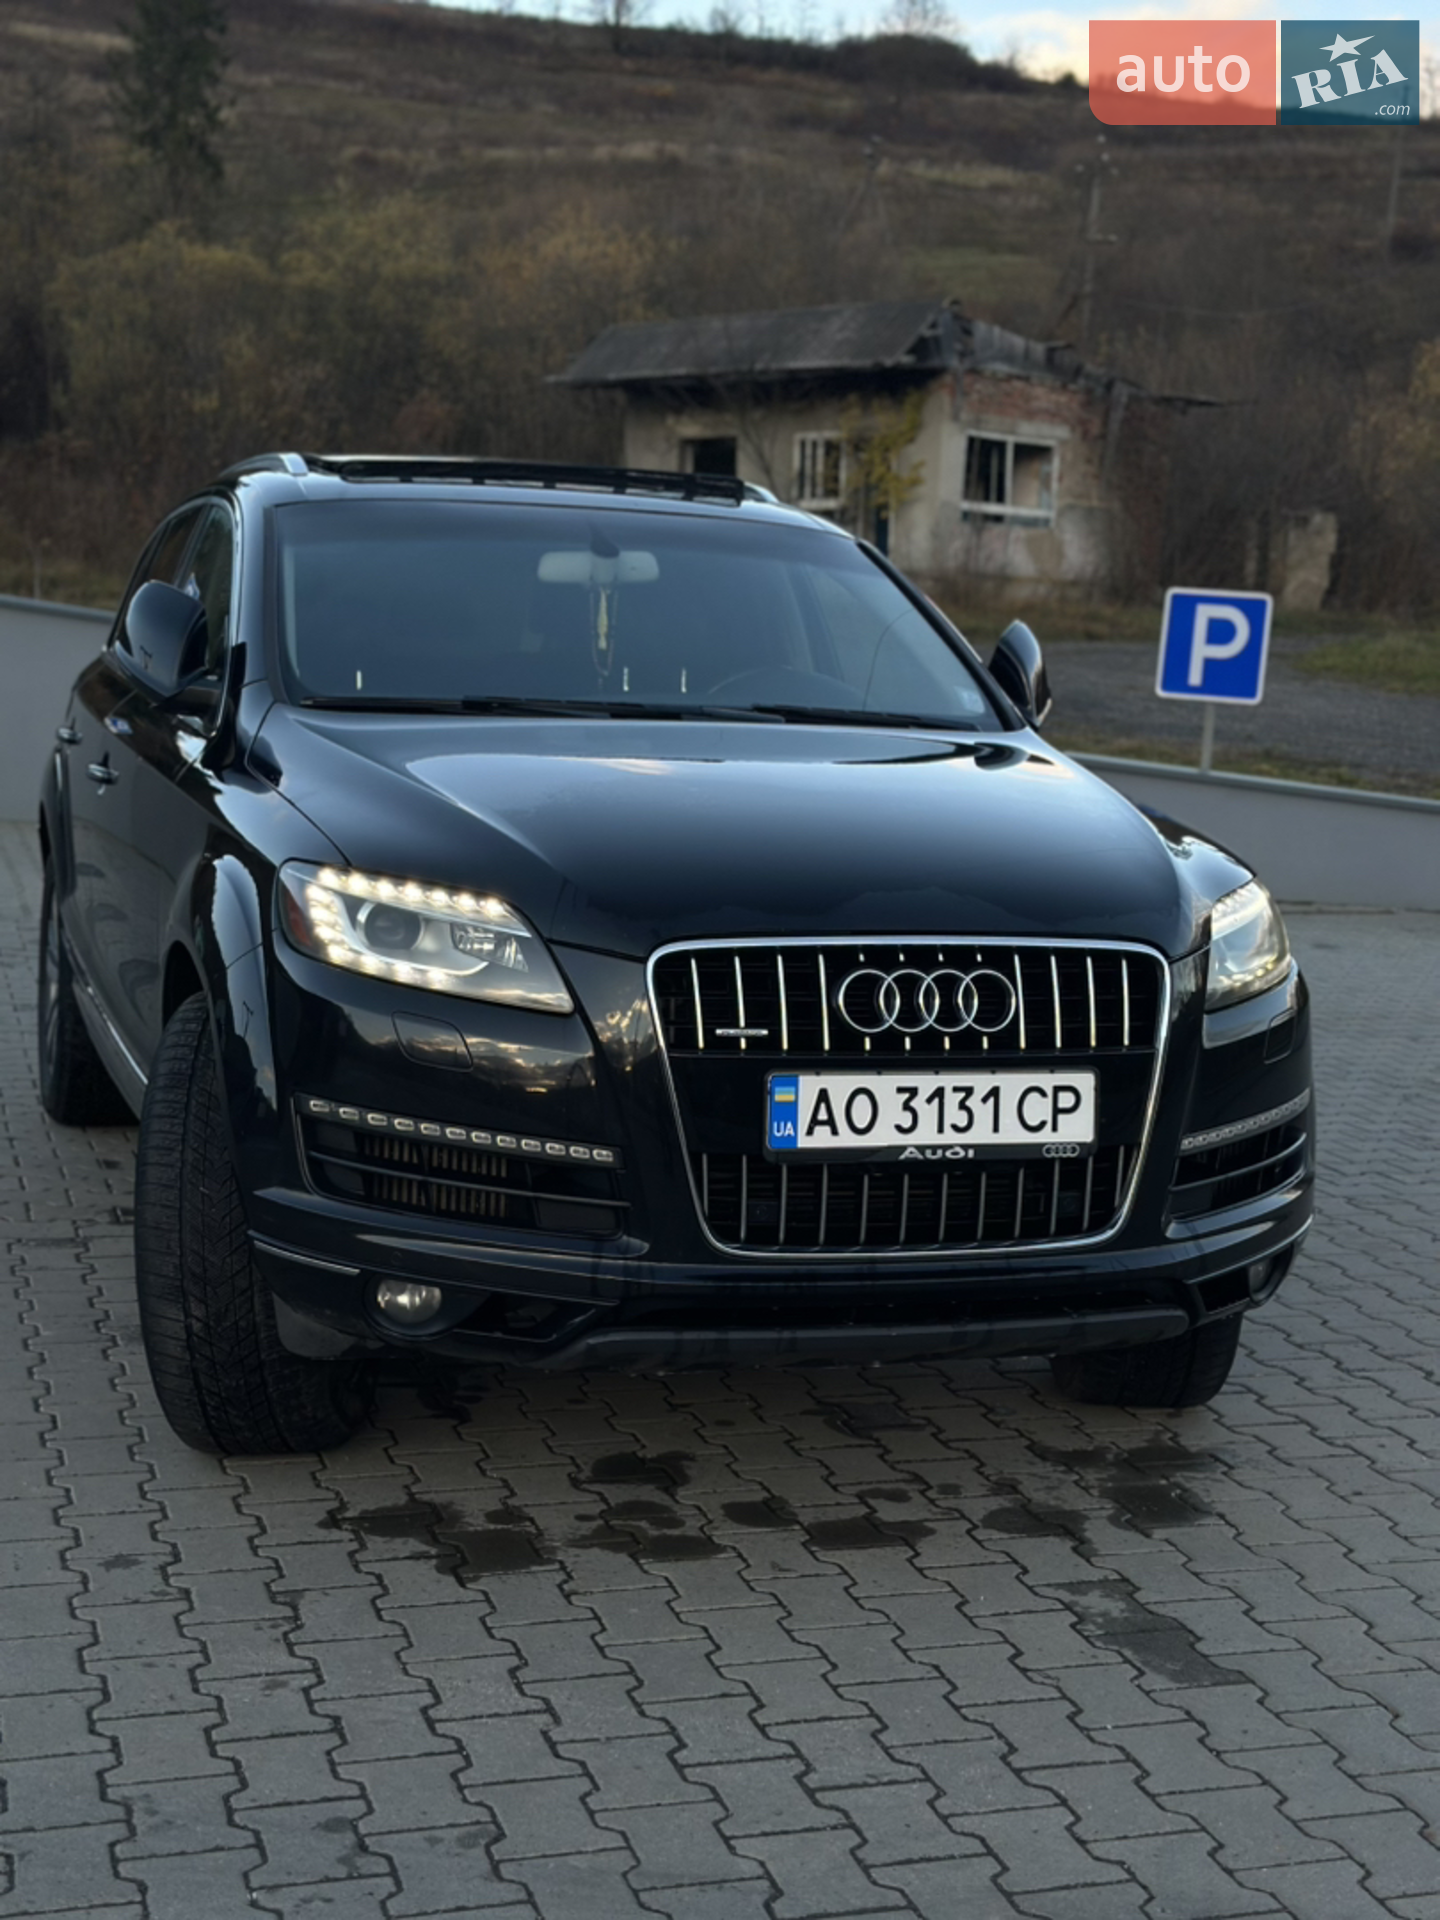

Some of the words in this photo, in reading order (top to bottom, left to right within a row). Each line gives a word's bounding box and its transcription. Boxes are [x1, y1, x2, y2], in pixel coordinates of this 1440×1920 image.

[1187, 602, 1251, 687] P
[805, 1086, 879, 1136] AO
[894, 1085, 1001, 1135] 3131
[1016, 1084, 1083, 1133] CP
[773, 1121, 795, 1137] UA
[899, 1146, 975, 1160] Audi
